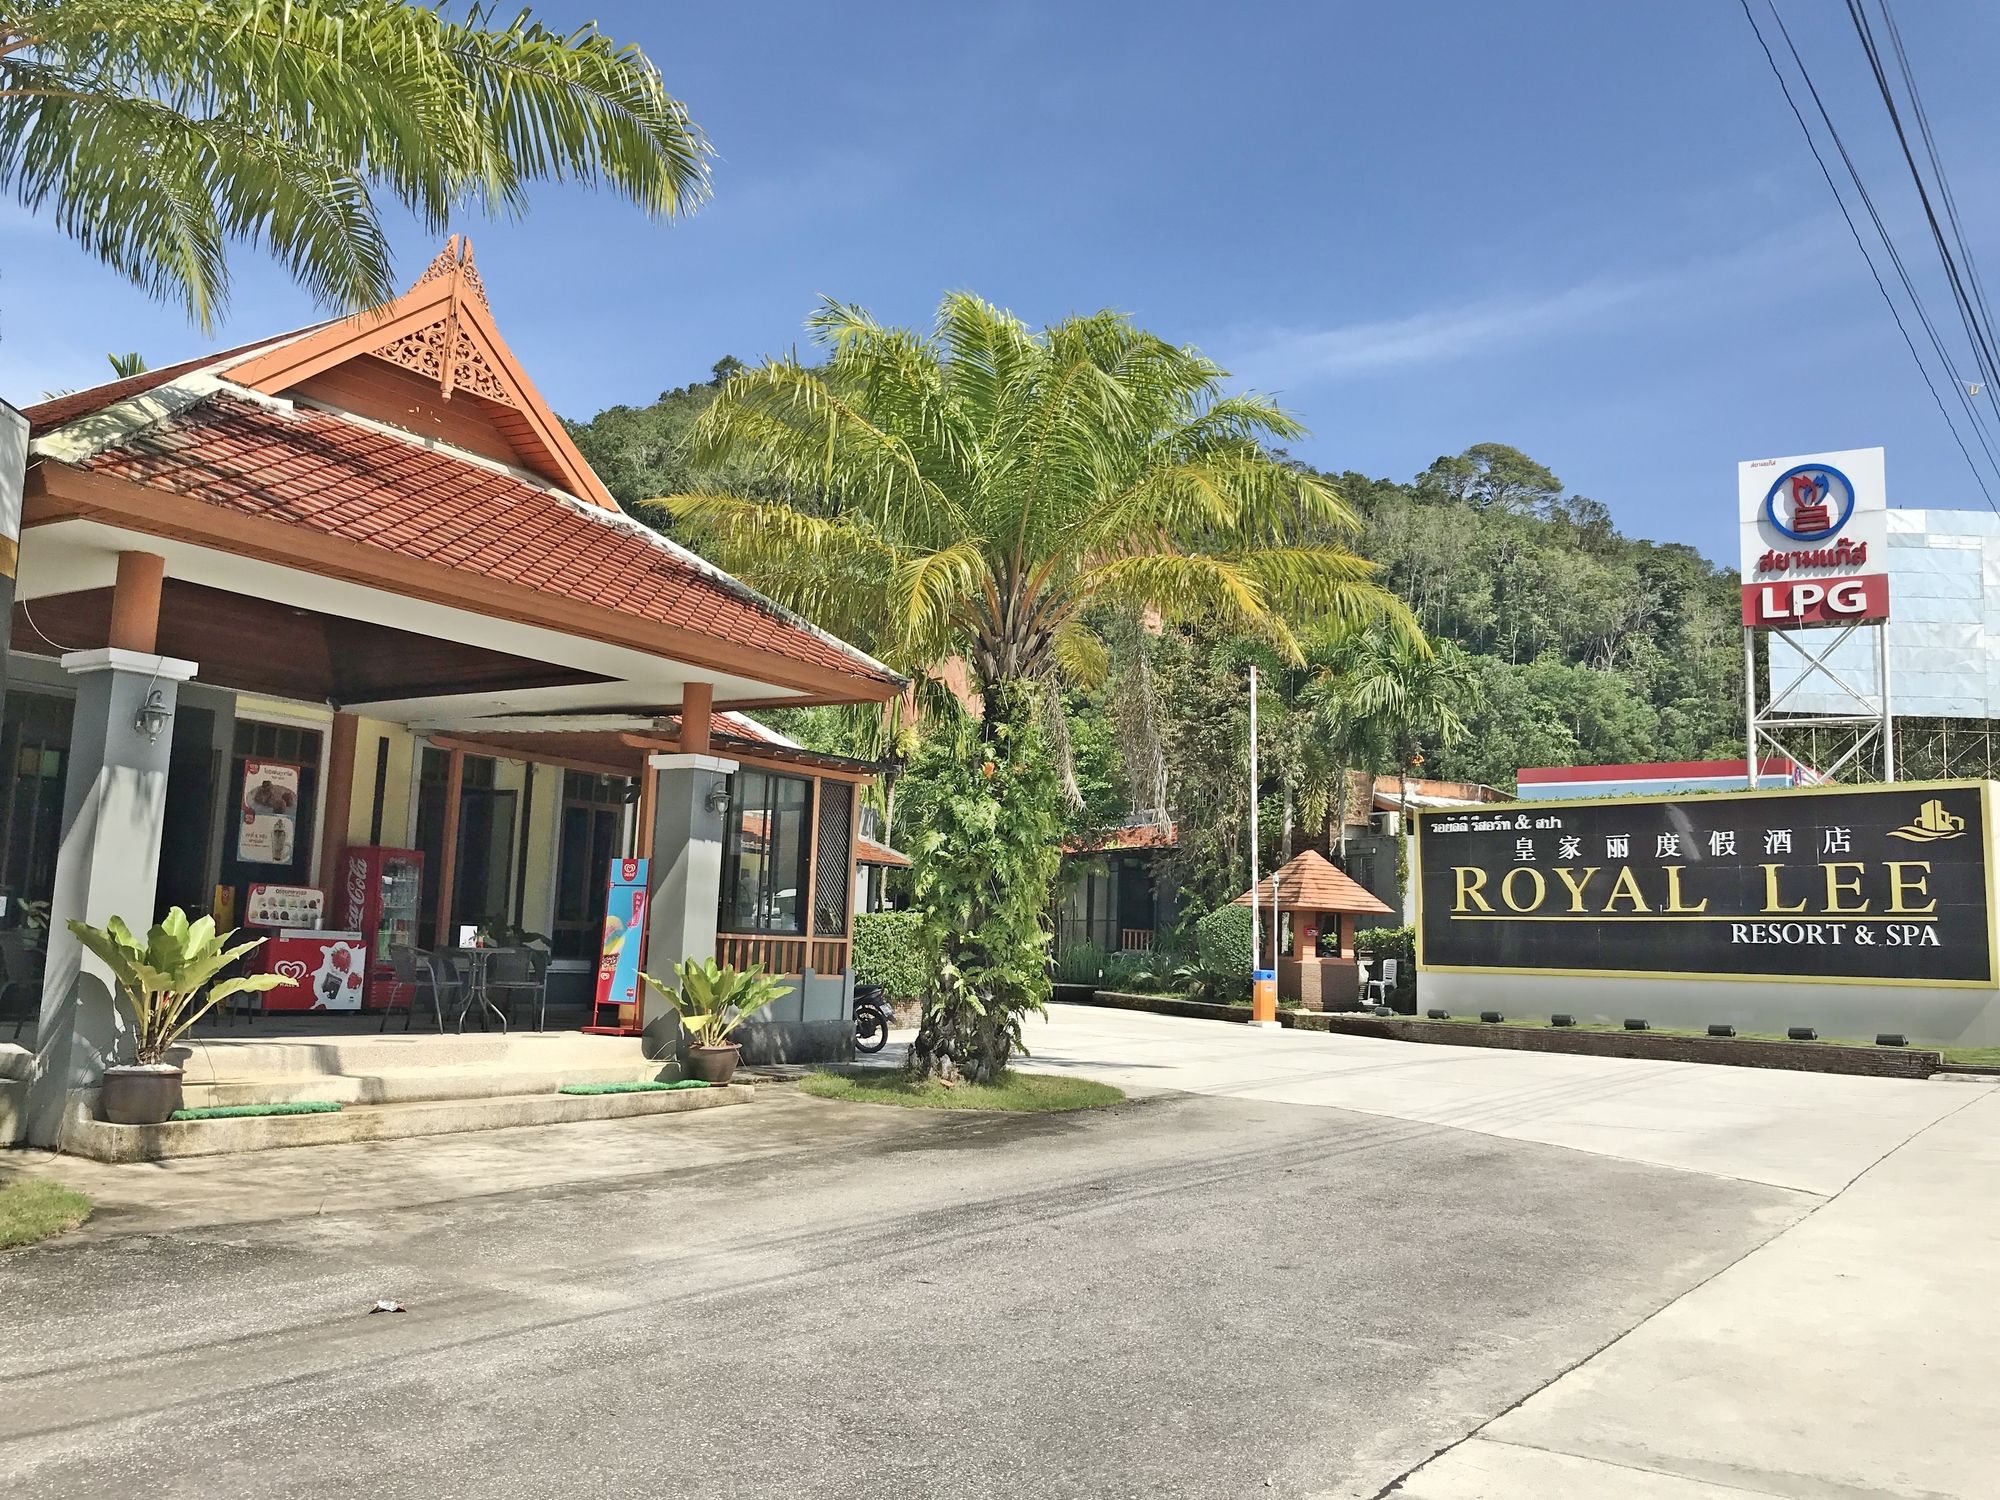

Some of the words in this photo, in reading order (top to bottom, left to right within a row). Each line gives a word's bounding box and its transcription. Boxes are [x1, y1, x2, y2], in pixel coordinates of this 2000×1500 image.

[1759, 537, 1867, 573] สยามแก๊ส
[1762, 580, 1867, 618] LPG
[1515, 814, 1532, 830] &
[1535, 815, 1562, 829] สปา
[1513, 827, 1851, 861] 皇家丽度假酒店
[1450, 865, 1708, 913] ROYAL
[1758, 861, 1937, 913] LEE
[1731, 923, 1846, 945] RESORT
[1854, 924, 1876, 946] &
[1886, 924, 1942, 947] SPA
